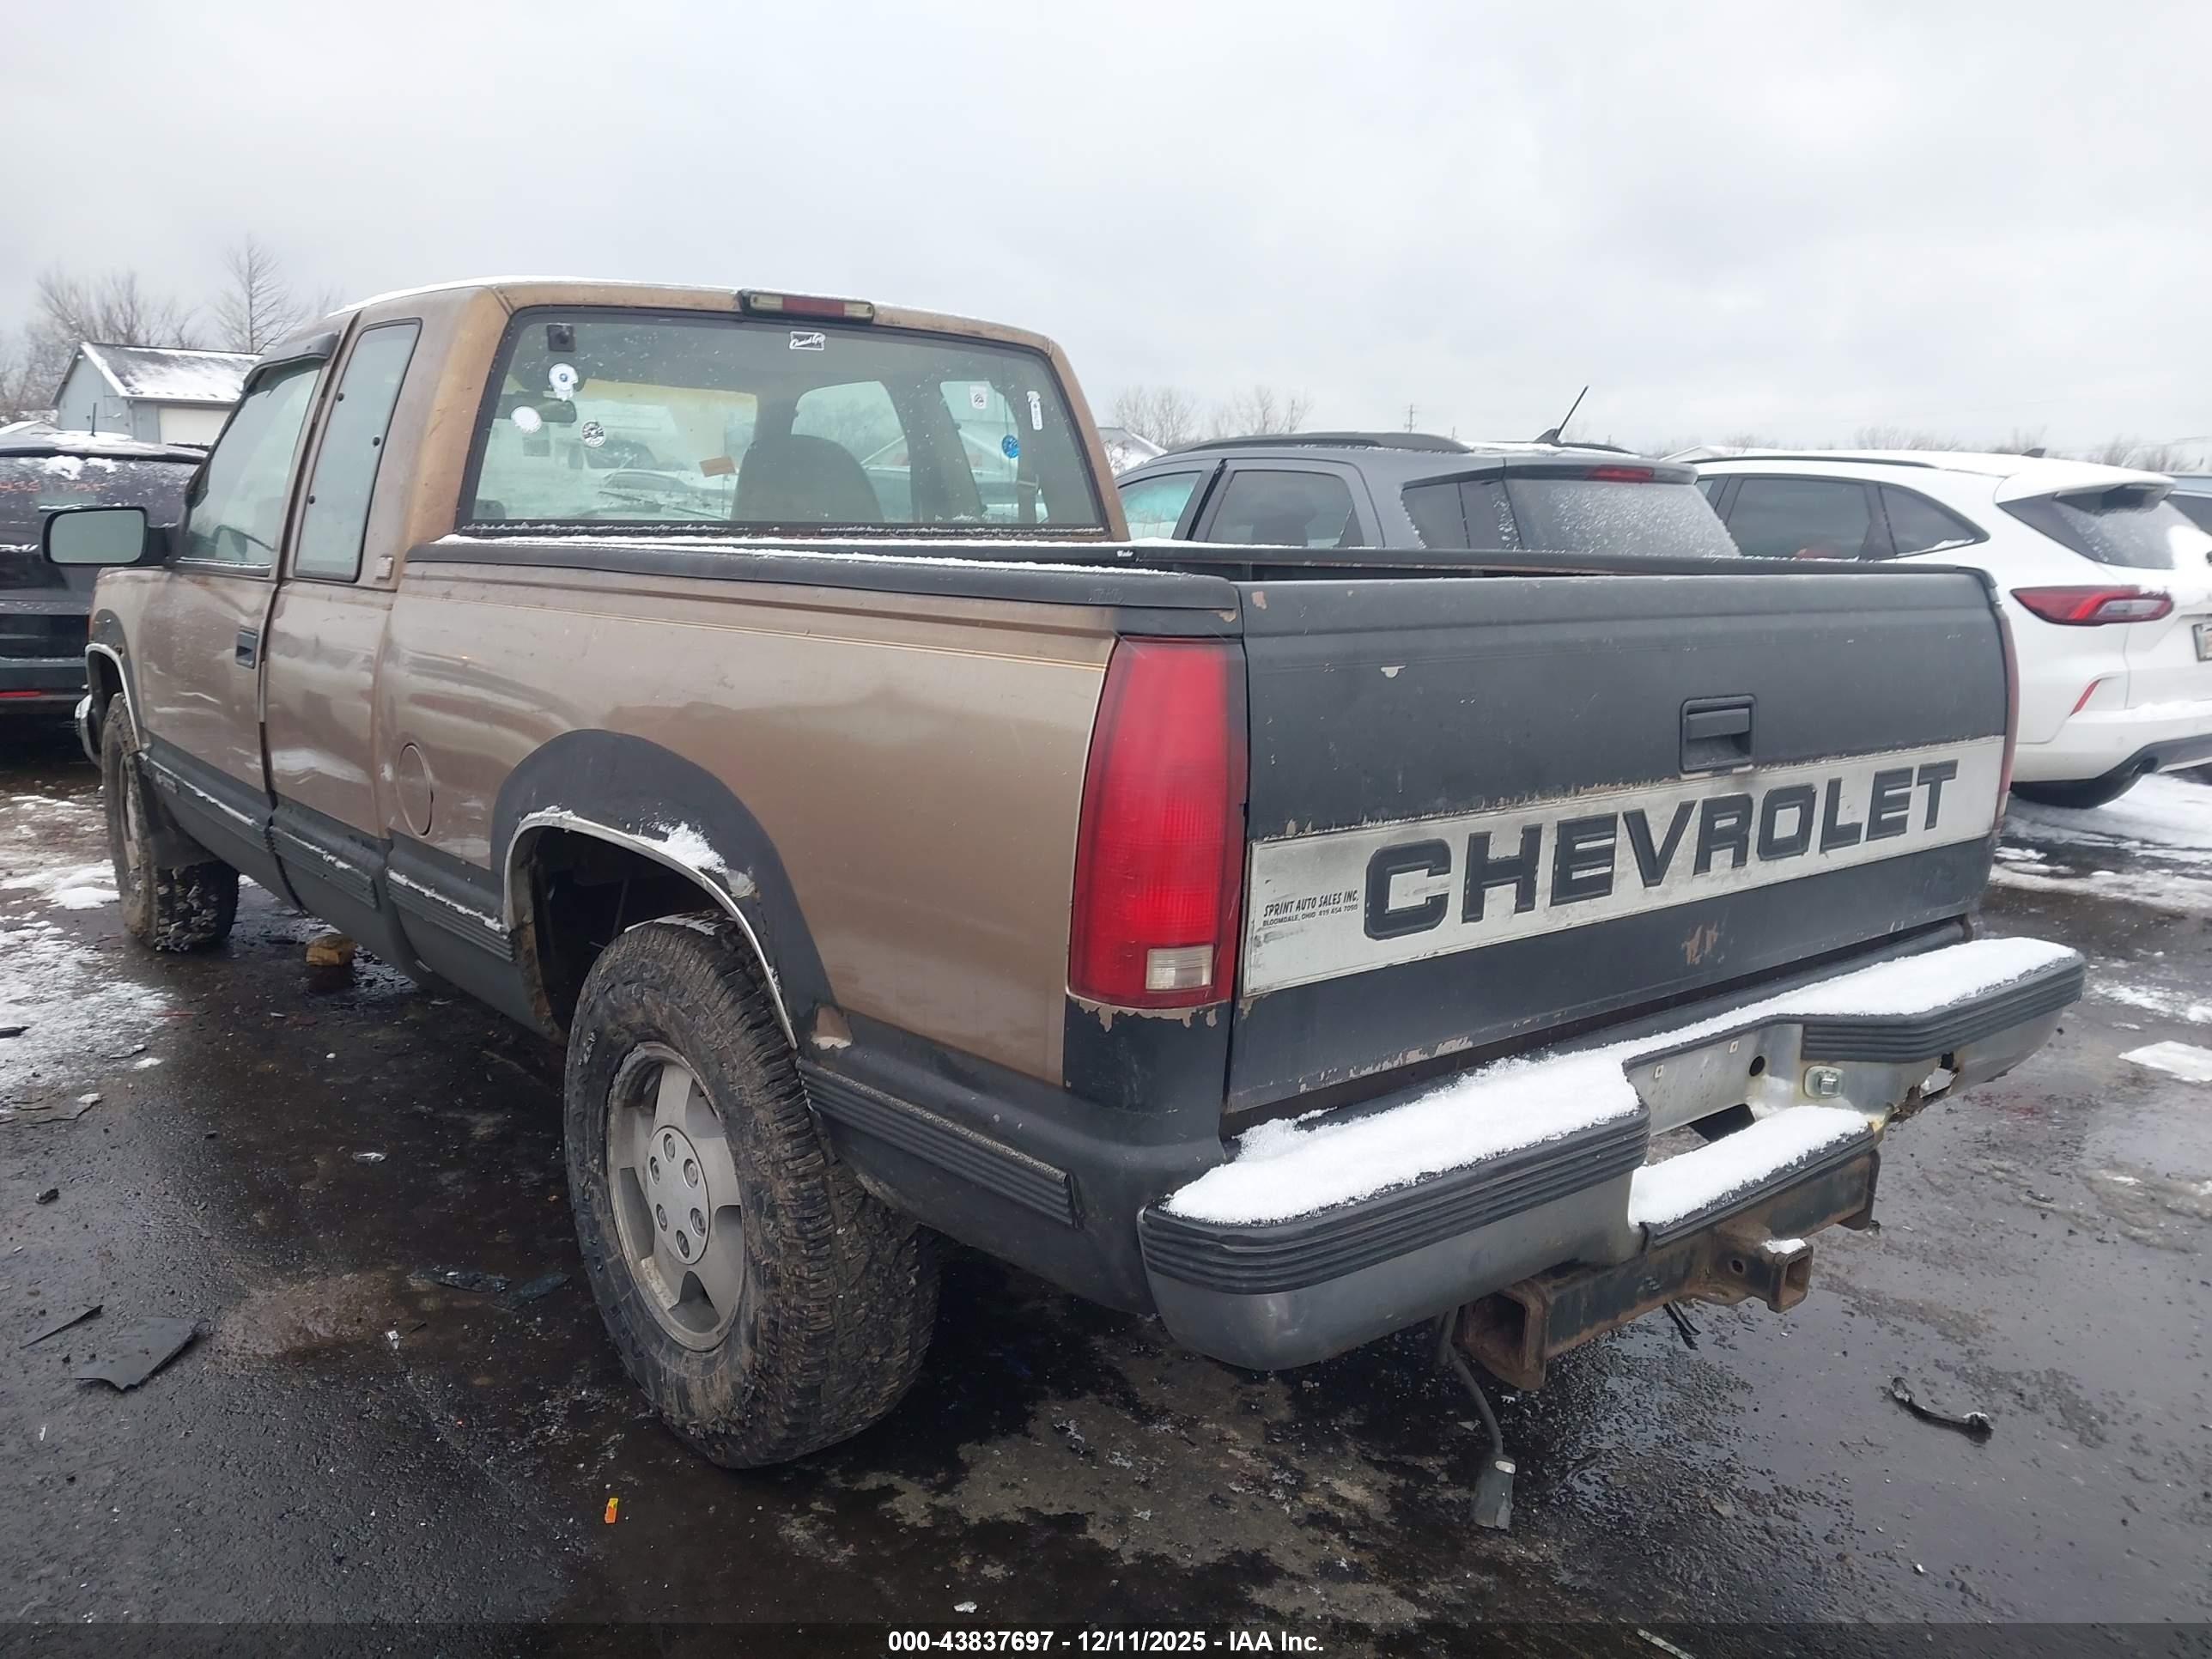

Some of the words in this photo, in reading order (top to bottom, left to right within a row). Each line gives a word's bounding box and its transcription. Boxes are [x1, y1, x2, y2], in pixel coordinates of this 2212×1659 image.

[1364, 760, 1958, 940] CHEVROLET
[1264, 901, 1294, 917] SPRINT
[1296, 897, 1317, 911] AUTO
[1318, 892, 1341, 908] SALES
[1343, 890, 1358, 903] INC.
[1301, 911, 1316, 920] OHIO
